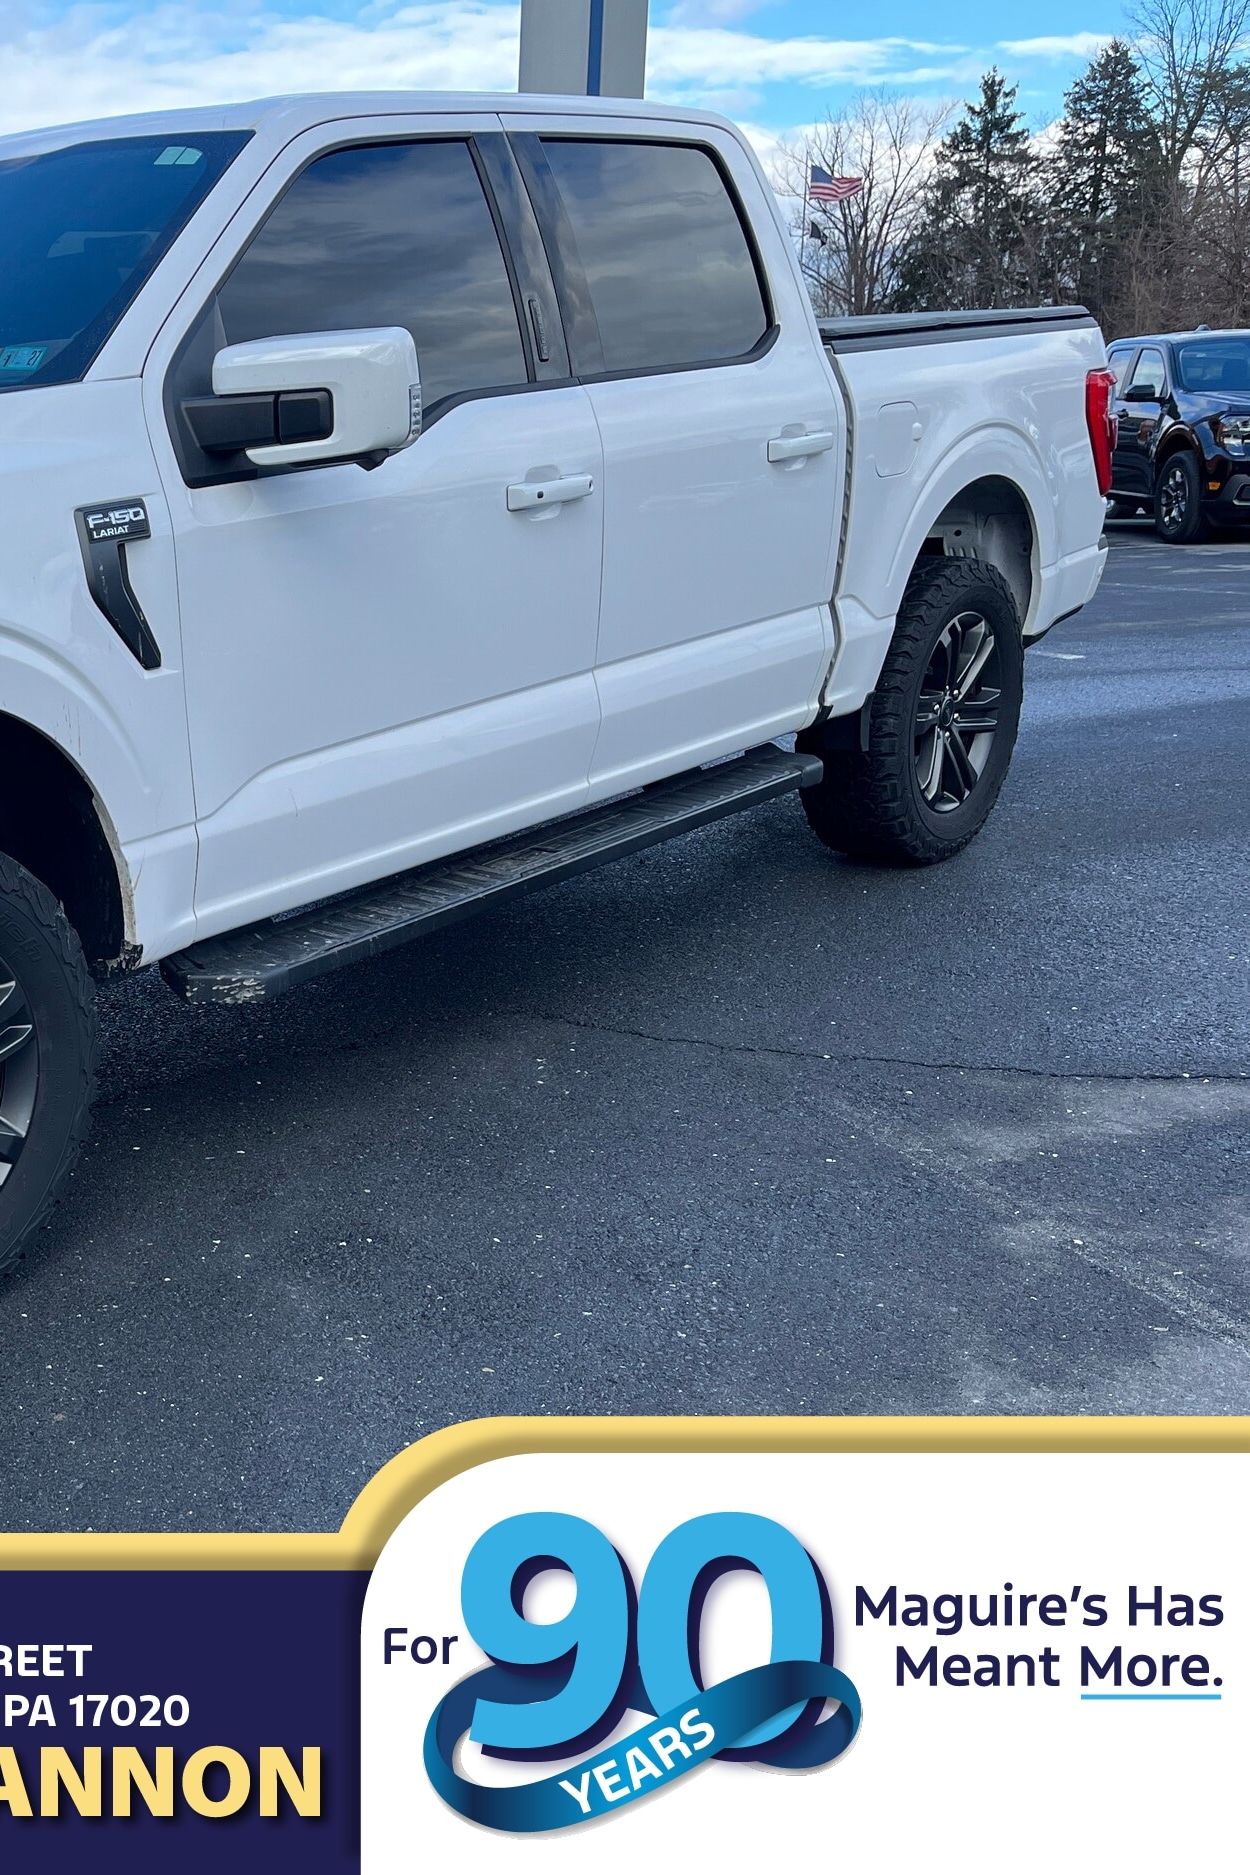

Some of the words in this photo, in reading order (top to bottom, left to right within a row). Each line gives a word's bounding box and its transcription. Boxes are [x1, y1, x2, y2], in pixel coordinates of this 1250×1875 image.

[27, 350, 42, 366] 27
[87, 507, 145, 528] F-150
[93, 525, 129, 538] LARIAT
